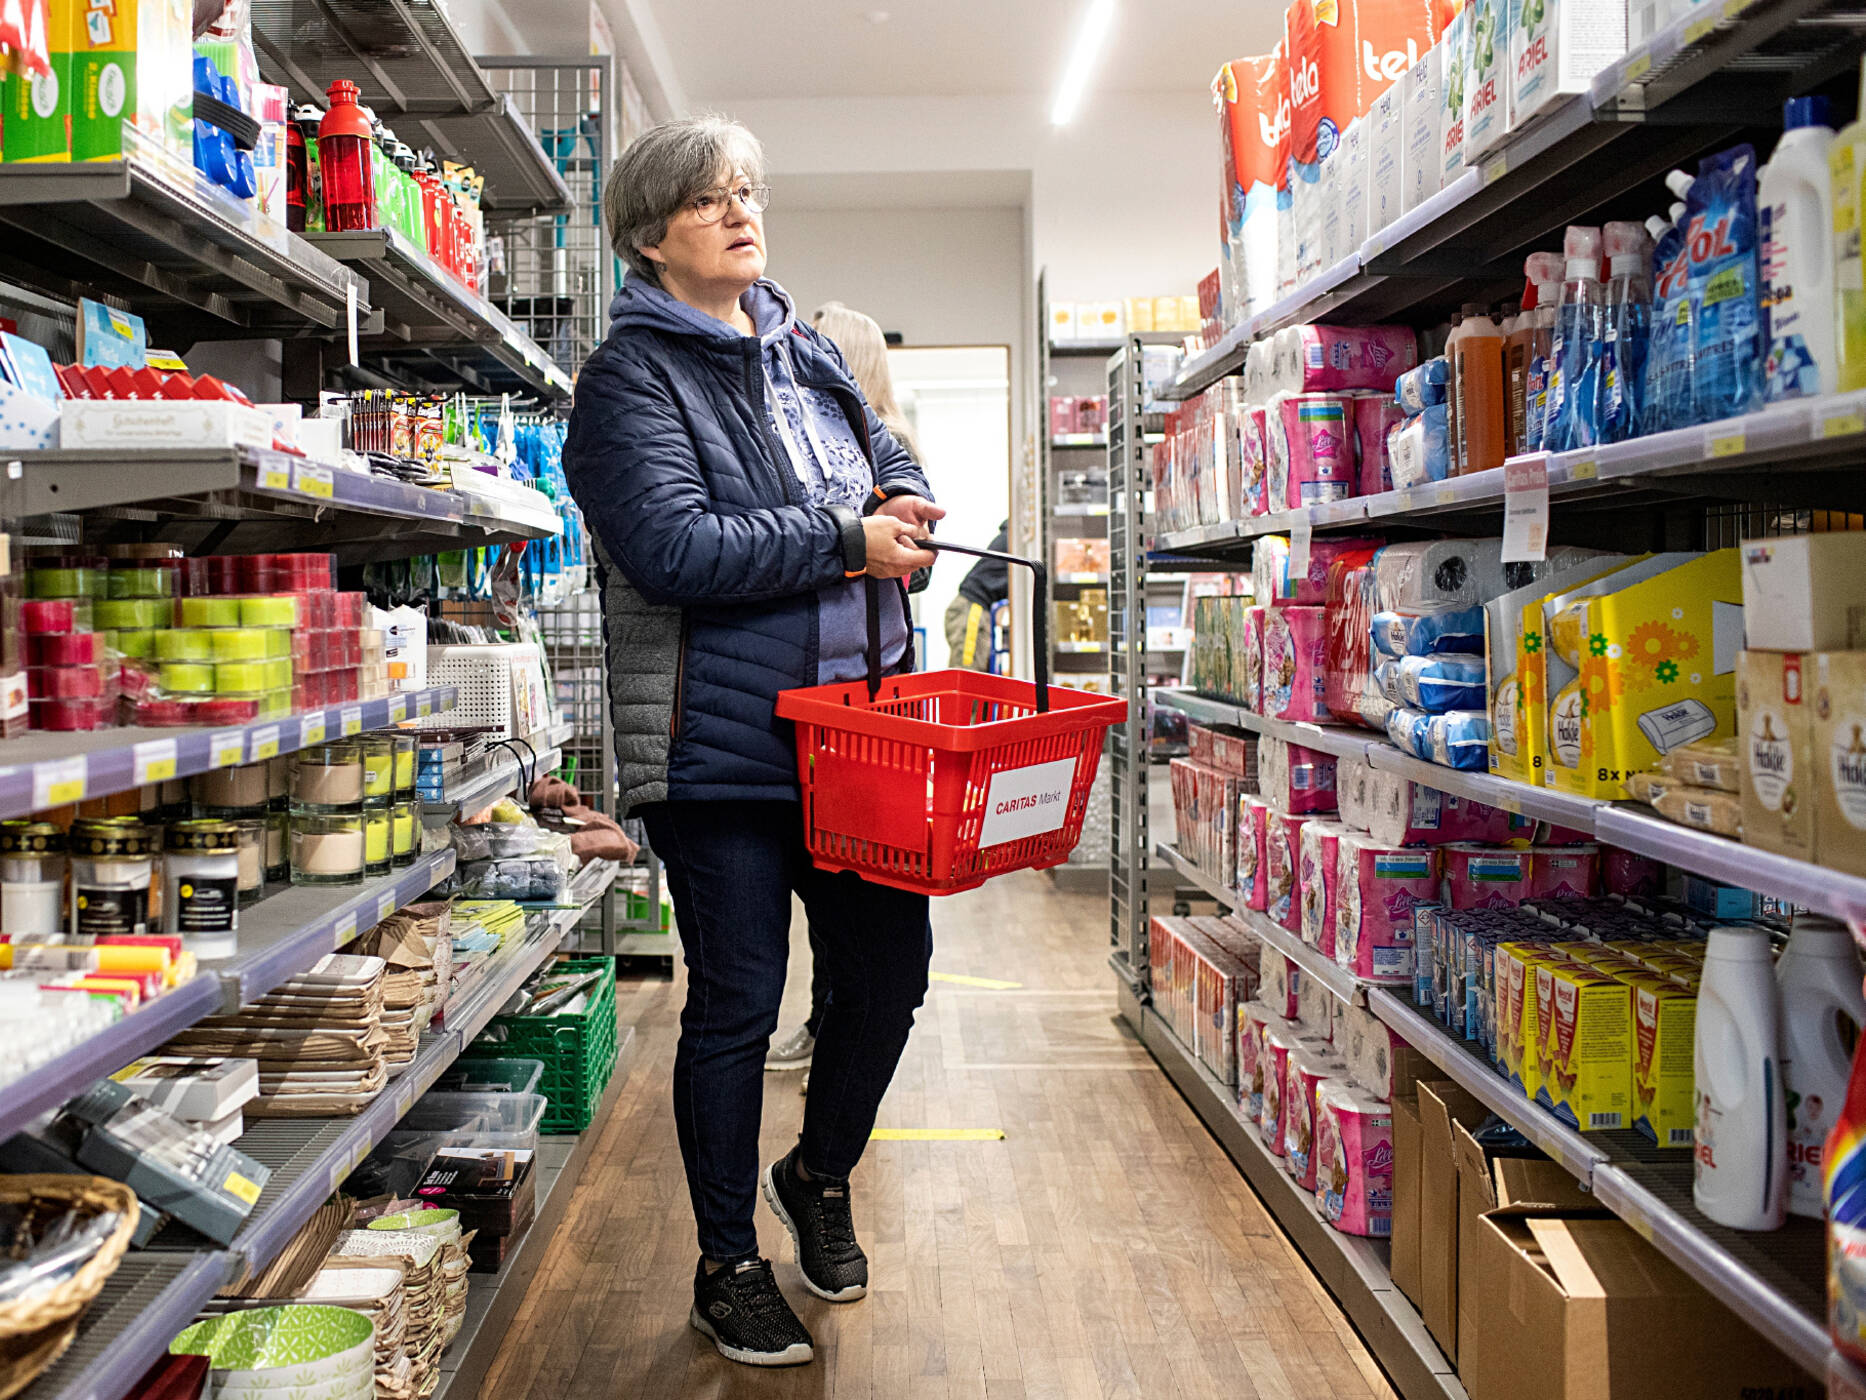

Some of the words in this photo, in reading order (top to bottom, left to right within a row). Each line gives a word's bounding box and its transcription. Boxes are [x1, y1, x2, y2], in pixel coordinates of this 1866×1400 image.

[1362, 37, 1422, 81] tel
[1517, 36, 1549, 81] ARIEL
[1290, 55, 1319, 108] tela
[1470, 78, 1498, 120] ARIEL
[1444, 119, 1464, 154] ARIE
[1557, 719, 1580, 743] Hakle
[1532, 755, 1542, 768] 8
[995, 794, 1038, 815] CARITAS
[1039, 790, 1061, 805] Markt
[1786, 1141, 1820, 1167] RIE
